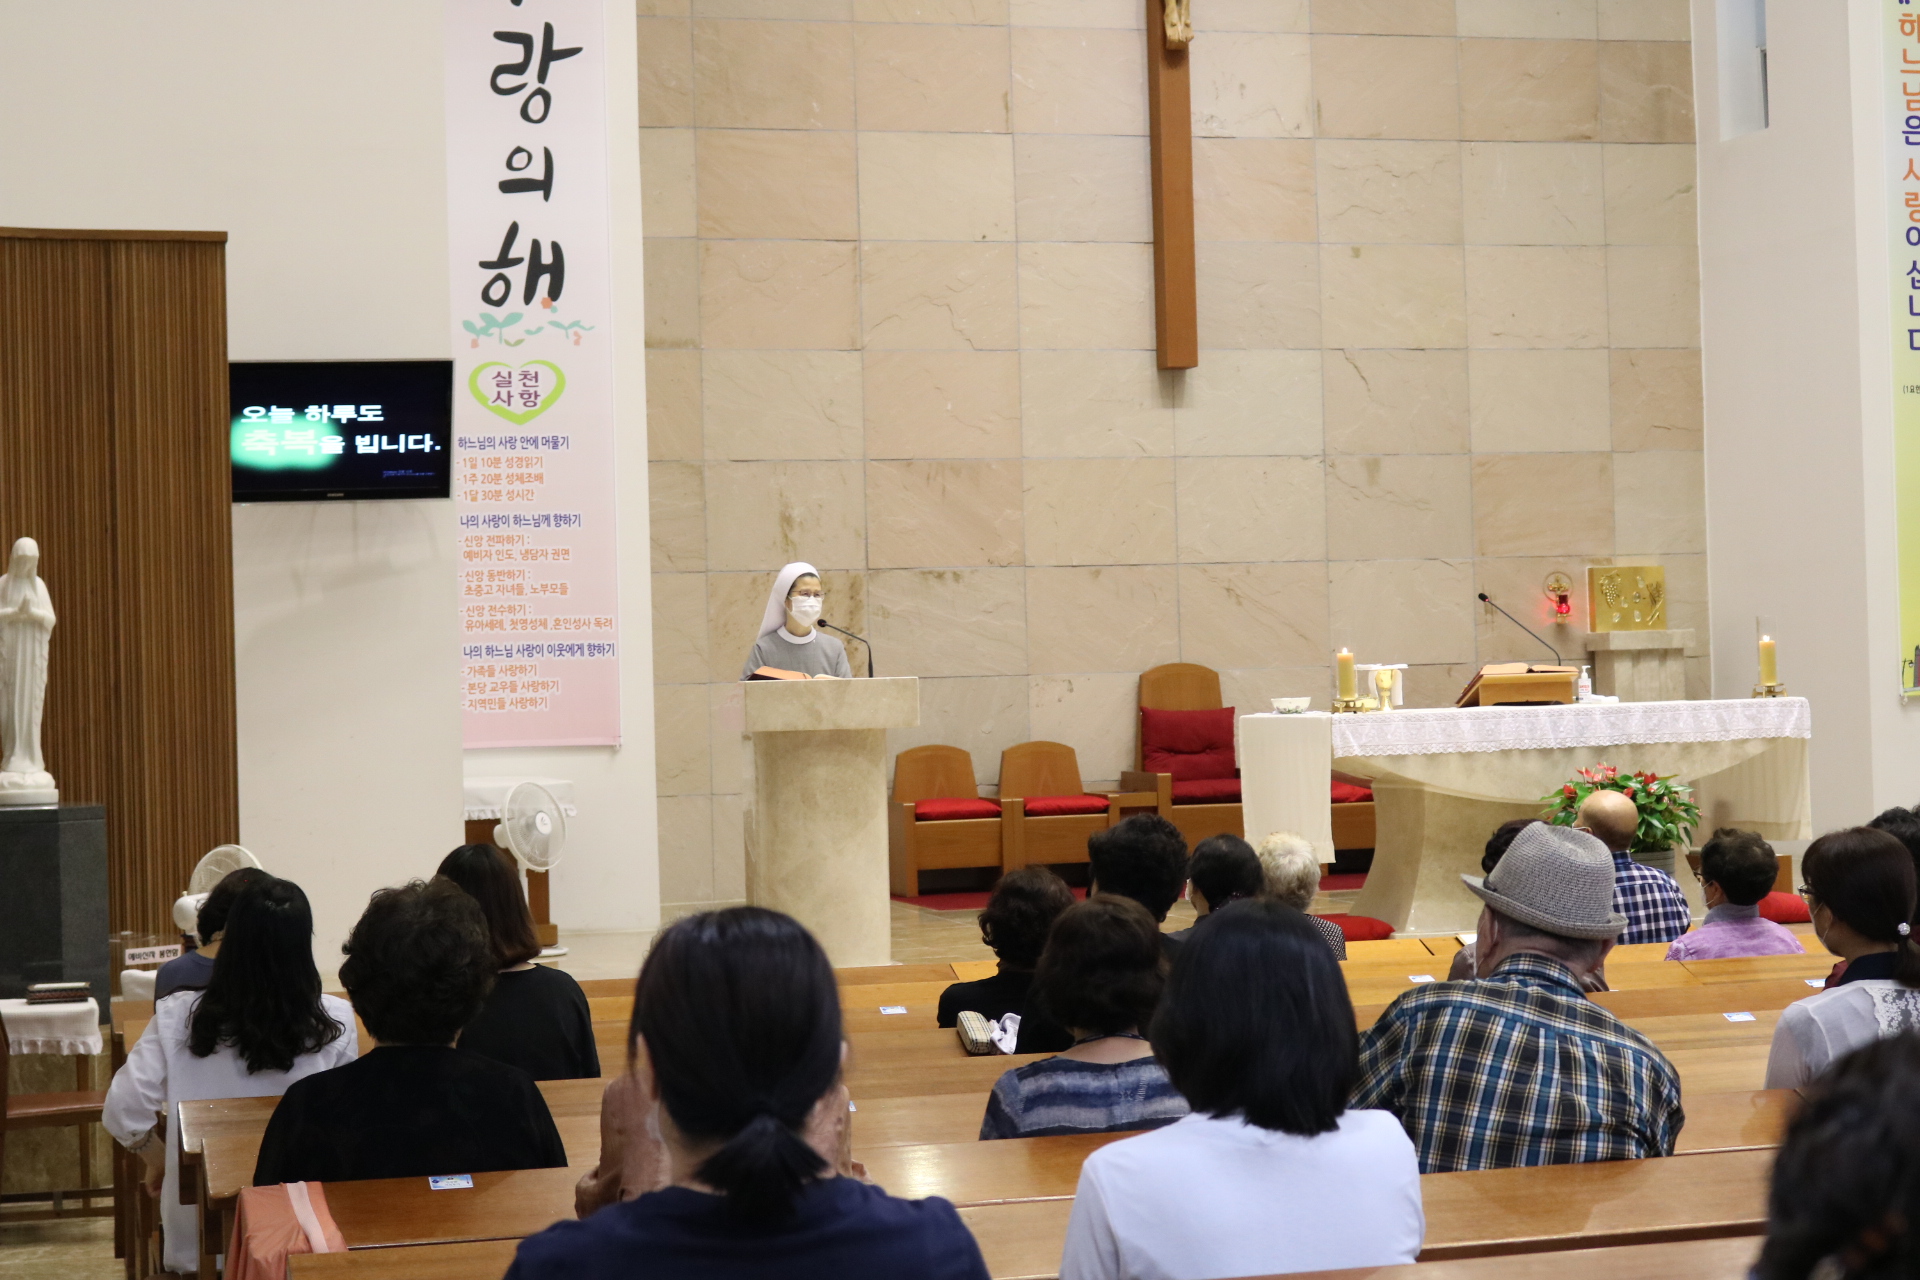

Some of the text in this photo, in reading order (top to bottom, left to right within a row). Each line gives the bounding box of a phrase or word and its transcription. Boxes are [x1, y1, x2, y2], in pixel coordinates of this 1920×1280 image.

[478, 0, 584, 307] 랑의 해
[491, 370, 540, 388] 실천
[491, 389, 541, 408] 사항
[241, 404, 384, 424] 오늘 하루도
[241, 429, 441, 456] 축복을 빕니다.
[458, 436, 569, 450] 하느님의 사랑 안에 머물기
[463, 456, 543, 469] 1일 10분 성경읽기
[463, 473, 544, 485] 1주 20분 성체조배
[464, 489, 534, 502] 1달 30분 성시간
[461, 514, 581, 528] 나의 사랑이 하느님께 향하기
[465, 536, 482, 547] 신앙
[463, 550, 492, 562] 예비자
[520, 549, 548, 560] 냉담자
[551, 549, 570, 560] 권면
[465, 570, 483, 582] 신앙
[465, 585, 494, 596] 초중고
[530, 583, 568, 595] 노부모들
[466, 606, 484, 617] 신앙
[594, 618, 612, 629] 독려
[463, 643, 614, 659] 나의 하느님 사랑이 이웃에게 향하기
[467, 665, 537, 678] 가족들 사랑하기
[468, 681, 559, 694] 본당 교우들 사랑하기
[468, 697, 548, 710] 지역민들 사랑하기
